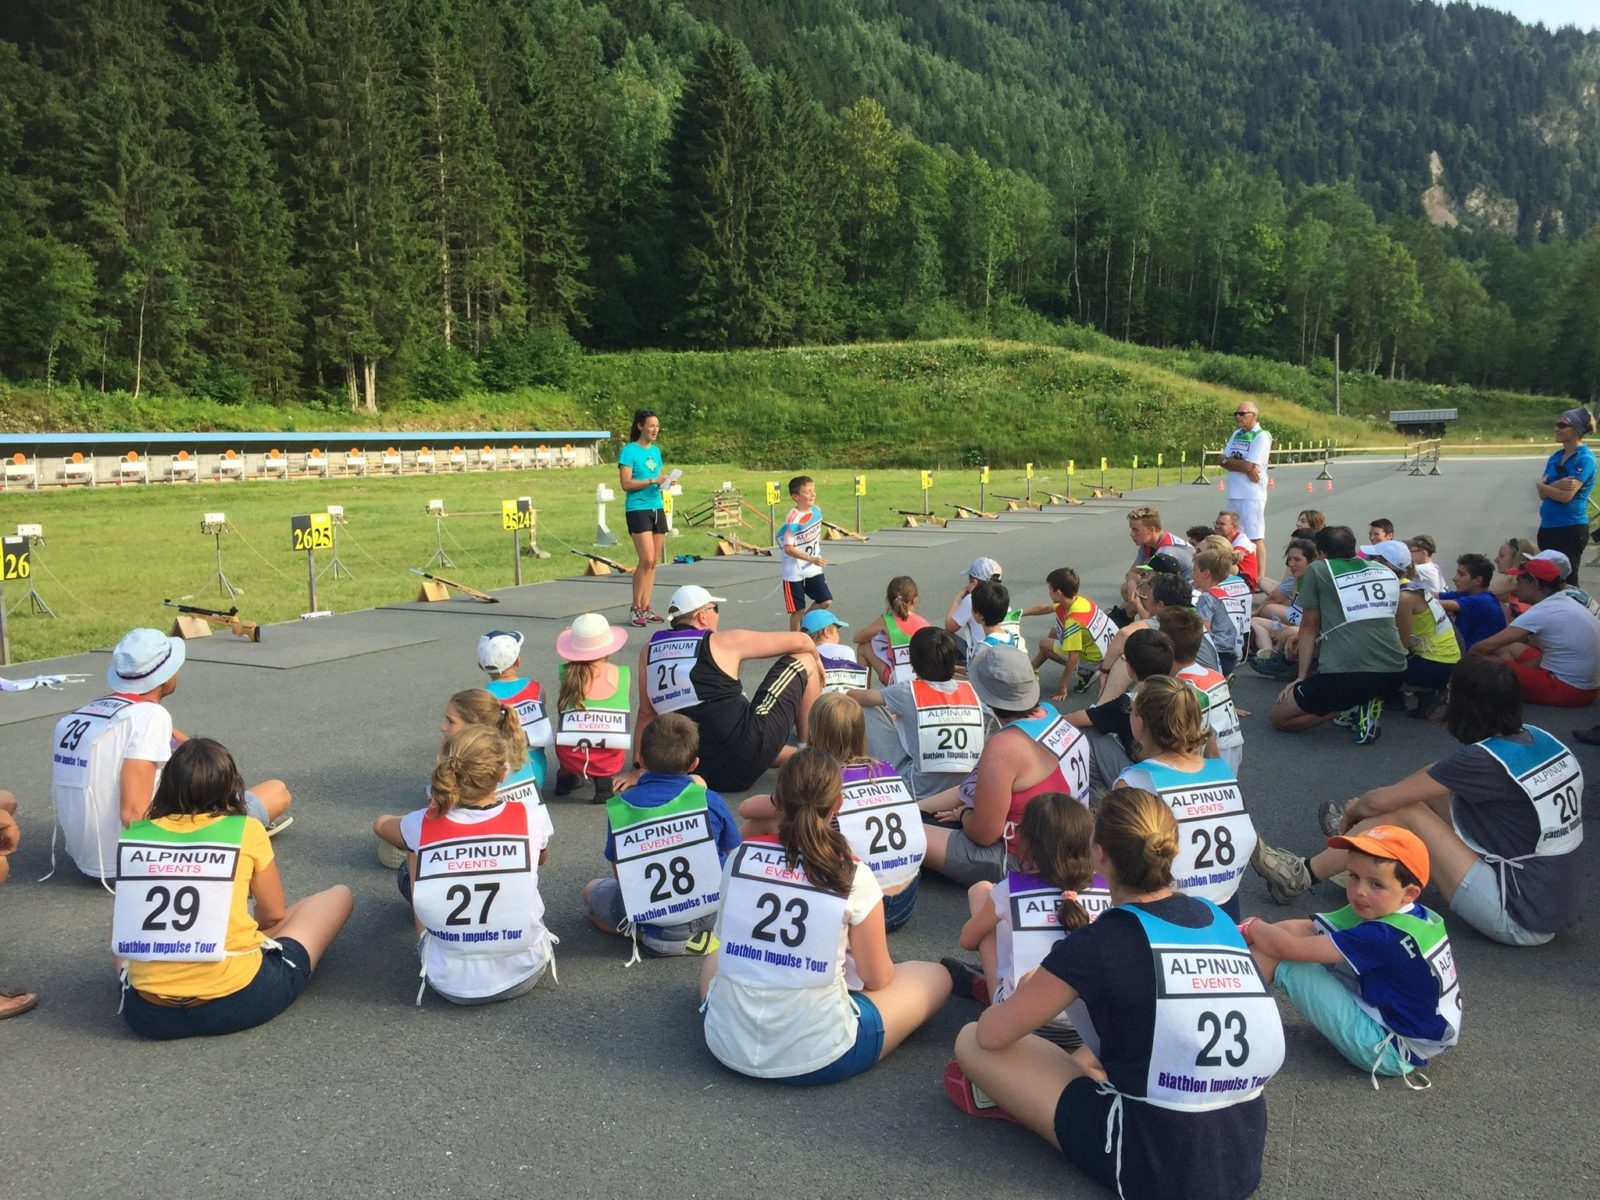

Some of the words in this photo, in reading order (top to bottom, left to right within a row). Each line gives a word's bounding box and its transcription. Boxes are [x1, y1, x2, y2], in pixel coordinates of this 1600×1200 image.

[294, 528, 312, 549] 26
[314, 527, 330, 547] 25
[5, 553, 30, 579] 26
[1358, 583, 1386, 601] 18
[653, 643, 694, 654] ALPINUM
[567, 713, 622, 724] ALPINUM
[928, 710, 971, 718] ALPINUM
[60, 719, 91, 751] 29
[938, 728, 967, 750] 20
[1070, 749, 1088, 791] 21
[1533, 760, 1569, 786] ALPINUM
[857, 796, 892, 807] EVENTS
[1171, 789, 1235, 807] ALPINUM
[1553, 785, 1578, 825] 20
[1187, 803, 1224, 816] EVENTS
[623, 818, 699, 847] ALPINUM
[865, 812, 906, 854] 28
[640, 834, 684, 852] EVENTS
[1191, 825, 1235, 870] 28
[130, 850, 226, 864] ALPINUM
[429, 845, 517, 863] ALPINUM
[448, 858, 497, 870] EVENTS
[882, 856, 908, 870] Impulse
[148, 864, 202, 874] EVENTS
[1209, 870, 1235, 884] Impulse
[644, 856, 695, 903] 28
[141, 885, 201, 932] 29
[445, 882, 501, 926] 27
[633, 906, 667, 923] Biathlon
[669, 897, 701, 914] Impulse
[702, 891, 720, 905] Tour
[751, 892, 809, 948] 23
[462, 930, 499, 943] Impulse
[502, 928, 523, 940] Tour
[118, 940, 151, 954] Biathlon
[152, 940, 192, 954] Impulse
[195, 941, 217, 953] Tour
[726, 942, 762, 961] Biathlon
[764, 950, 802, 969] Impulse
[805, 956, 828, 973] Tour
[1170, 958, 1254, 975] ALPINUM
[1192, 978, 1242, 988] EVENTS
[1195, 1010, 1249, 1067] 23
[1158, 1072, 1208, 1093] Biathlon
[1210, 1077, 1248, 1092] Impulse
